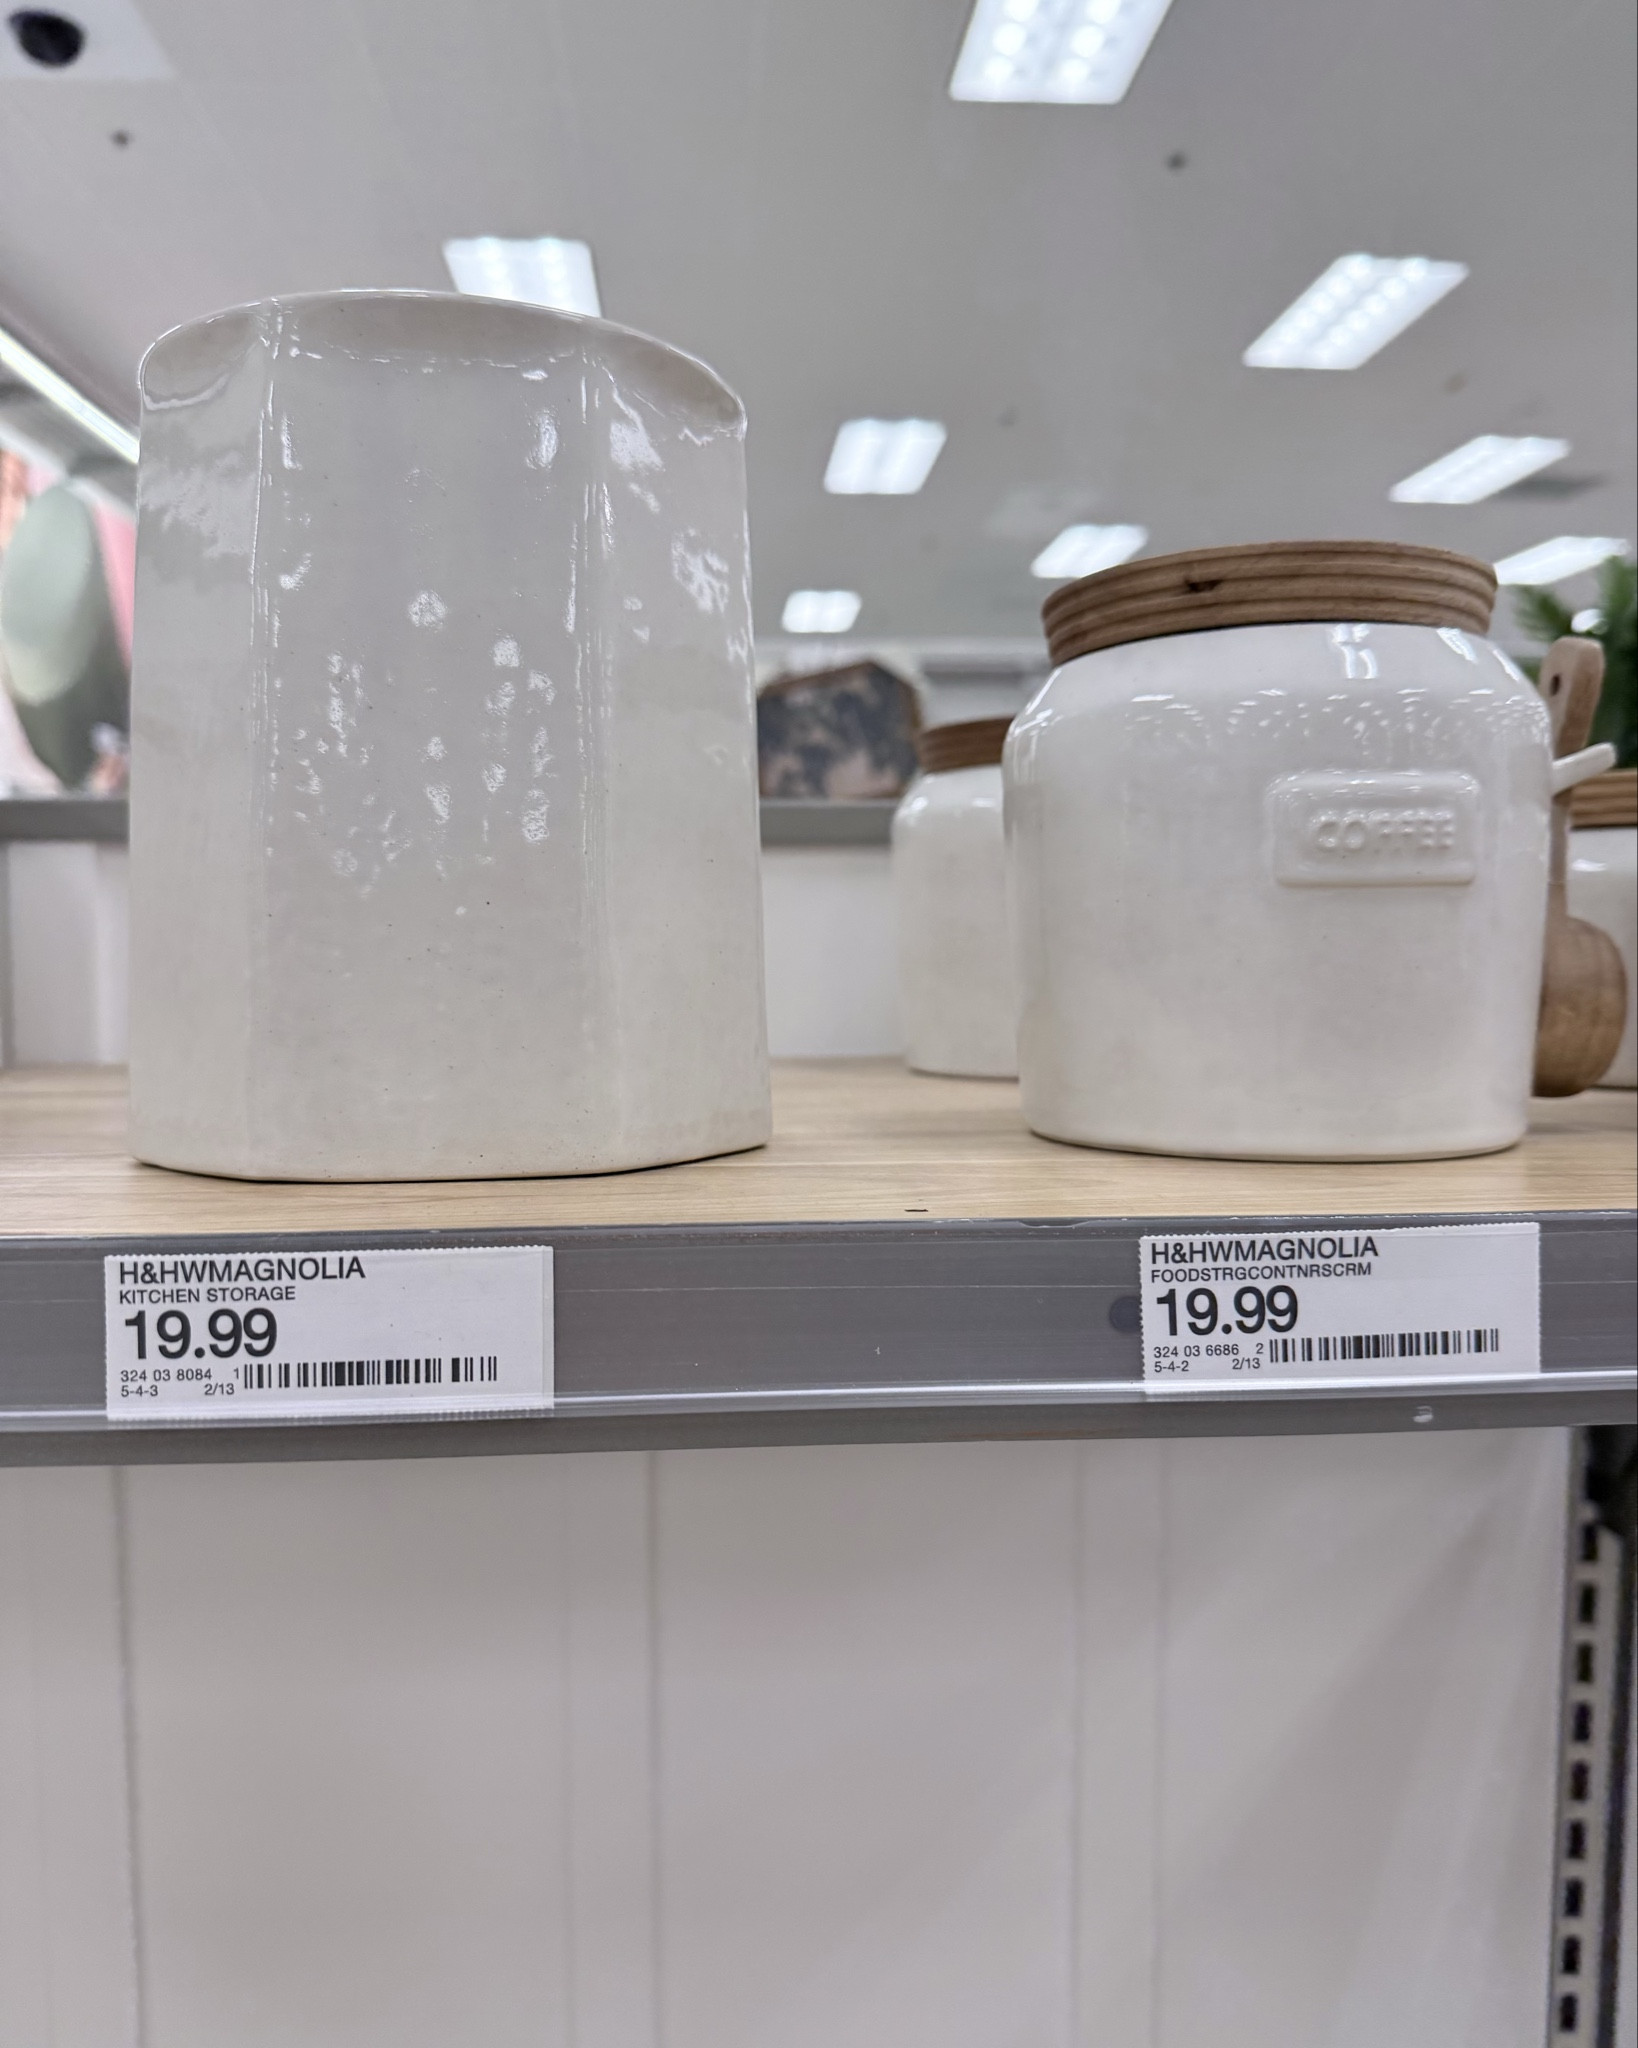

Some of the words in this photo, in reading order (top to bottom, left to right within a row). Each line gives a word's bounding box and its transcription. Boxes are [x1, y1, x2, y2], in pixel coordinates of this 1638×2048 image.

[1313, 808, 1457, 852] COFFEE
[1150, 1235, 1379, 1264] H&HWMAGNOLIA
[118, 1255, 367, 1284] H&HWMAGNOLIA
[1150, 1262, 1373, 1283] FOODSTRGCONTNRSCRM
[118, 1287, 201, 1305] KITCHEN
[206, 1285, 297, 1303] STORAGE
[1156, 1284, 1299, 1337] 19.99
[124, 1307, 278, 1360] 19.99
[1153, 1345, 1180, 1359] 324
[1183, 1344, 1202, 1358] 03
[1205, 1343, 1240, 1357] 6686
[1255, 1342, 1264, 1355] 2
[120, 1368, 148, 1382] 324
[152, 1368, 172, 1382] 03
[176, 1367, 213, 1381] 8084
[233, 1367, 240, 1380] 1
[1153, 1360, 1190, 1373] 5-4-2
[1231, 1357, 1261, 1371] 2/13
[120, 1384, 159, 1398] 5-4-3
[204, 1382, 235, 1396] 2/13
